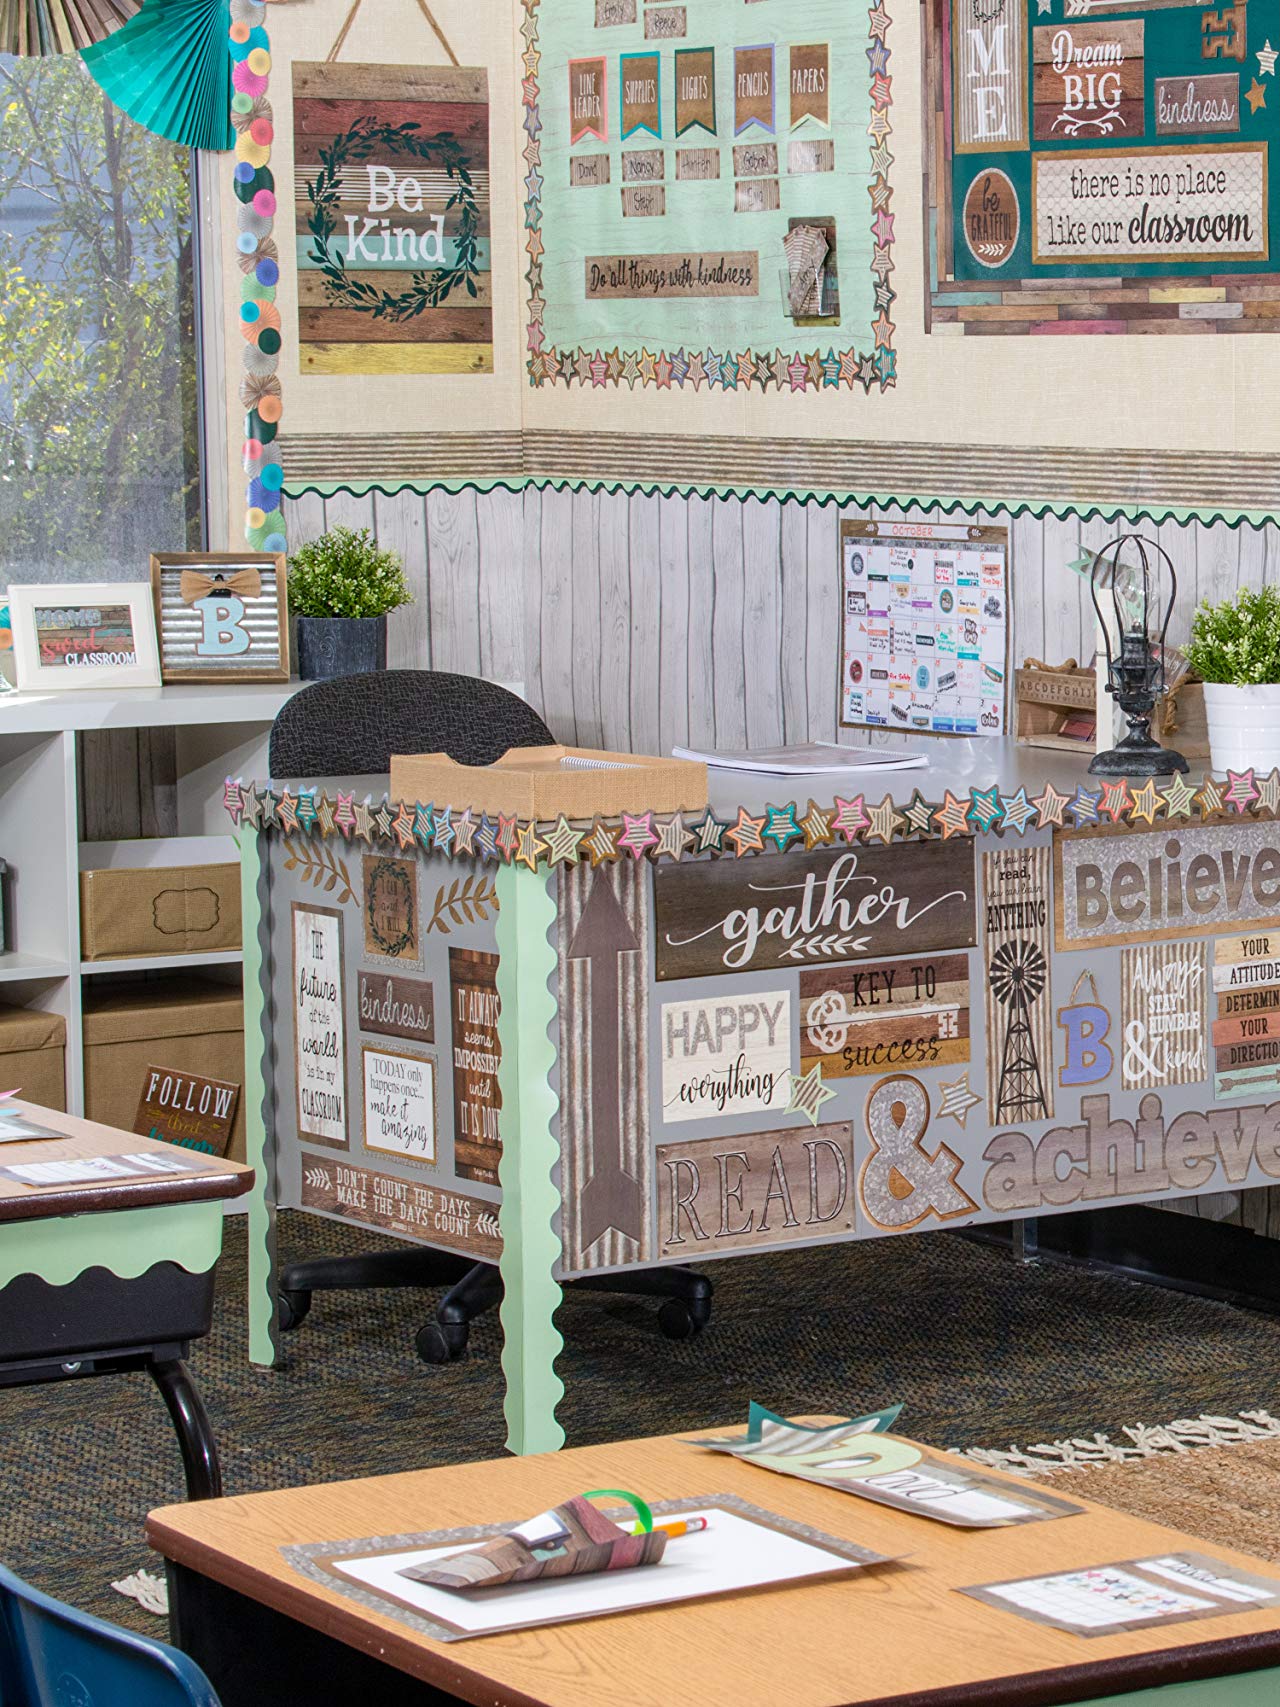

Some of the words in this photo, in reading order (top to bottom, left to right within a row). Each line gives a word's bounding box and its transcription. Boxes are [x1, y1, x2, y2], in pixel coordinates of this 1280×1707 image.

[1051, 30, 1125, 72] Dream
[579, 73, 596, 95] LINE
[625, 79, 656, 104] SUPPLIES
[682, 75, 708, 100] LIGHTS
[738, 71, 769, 97] PENCILS
[792, 68, 825, 94] PAPERS
[1063, 72, 1123, 111] BIG
[574, 95, 601, 119] LEADER
[1158, 82, 1235, 125] kindness
[366, 164, 424, 213] Be
[982, 177, 1000, 212] be
[1071, 168, 1119, 199] there
[1124, 167, 1144, 197] is
[1150, 174, 1170, 197] no
[1176, 164, 1226, 203] place
[344, 213, 447, 263] Kind
[971, 212, 1013, 242] GRATEFUL
[1048, 215, 1086, 246] like
[1092, 221, 1123, 245] our
[1128, 202, 1253, 245] classroom
[591, 264, 607, 292] Do
[609, 259, 628, 288] all
[629, 259, 666, 293] things
[669, 258, 694, 288] with
[698, 257, 753, 287] kindness
[892, 525, 933, 537] OCTOBER
[35, 609, 102, 628] HOME
[192, 599, 253, 656] B
[65, 651, 137, 666] CLASSROOM
[1000, 866, 1031, 880] read,
[666, 853, 967, 968] gather
[987, 900, 1046, 933] ANYTHING
[311, 930, 324, 960] THE
[1241, 937, 1270, 956] YOUR
[300, 967, 337, 1007] future
[853, 969, 896, 1007] KEY
[911, 965, 936, 1000] TO
[1132, 953, 1206, 998] Always
[1229, 962, 1280, 985] ATTITUDE
[361, 978, 431, 1030] kindness
[458, 988, 466, 1021] IT
[469, 991, 499, 1028] ALWAYS
[1148, 995, 1178, 1015] STAY
[464, 1031, 494, 1048] seems
[666, 1000, 784, 1058] HAPPY
[1149, 1012, 1201, 1035] HUMBLE
[1240, 1017, 1268, 1037] YOUR
[303, 1031, 339, 1058] world
[842, 1036, 943, 1071] success
[1057, 1003, 1114, 1088] B
[1122, 1019, 1165, 1082] &
[1163, 1034, 1206, 1071] kind
[370, 1076, 400, 1096] happens
[372, 1057, 407, 1079] TODAY
[407, 1064, 423, 1083] only
[663, 1053, 792, 1110] everything
[146, 1073, 234, 1119] FOLLOW
[302, 1088, 342, 1122] CLASSROOM
[469, 1078, 491, 1099] until
[370, 1094, 397, 1117] make
[400, 1098, 409, 1122] it
[461, 1100, 468, 1134] IT
[471, 1103, 479, 1136] IS
[381, 1118, 429, 1150] amazing
[664, 1139, 847, 1245] READ
[857, 1074, 981, 1232] &
[336, 1167, 367, 1191] DON'T
[373, 1177, 408, 1201] COUNT
[413, 1188, 434, 1209] THE
[441, 1195, 471, 1219] DAYS
[336, 1185, 367, 1209] MAKE
[373, 1195, 393, 1216] THE
[400, 1202, 428, 1226] DAYS
[434, 1212, 470, 1238] COUNT
